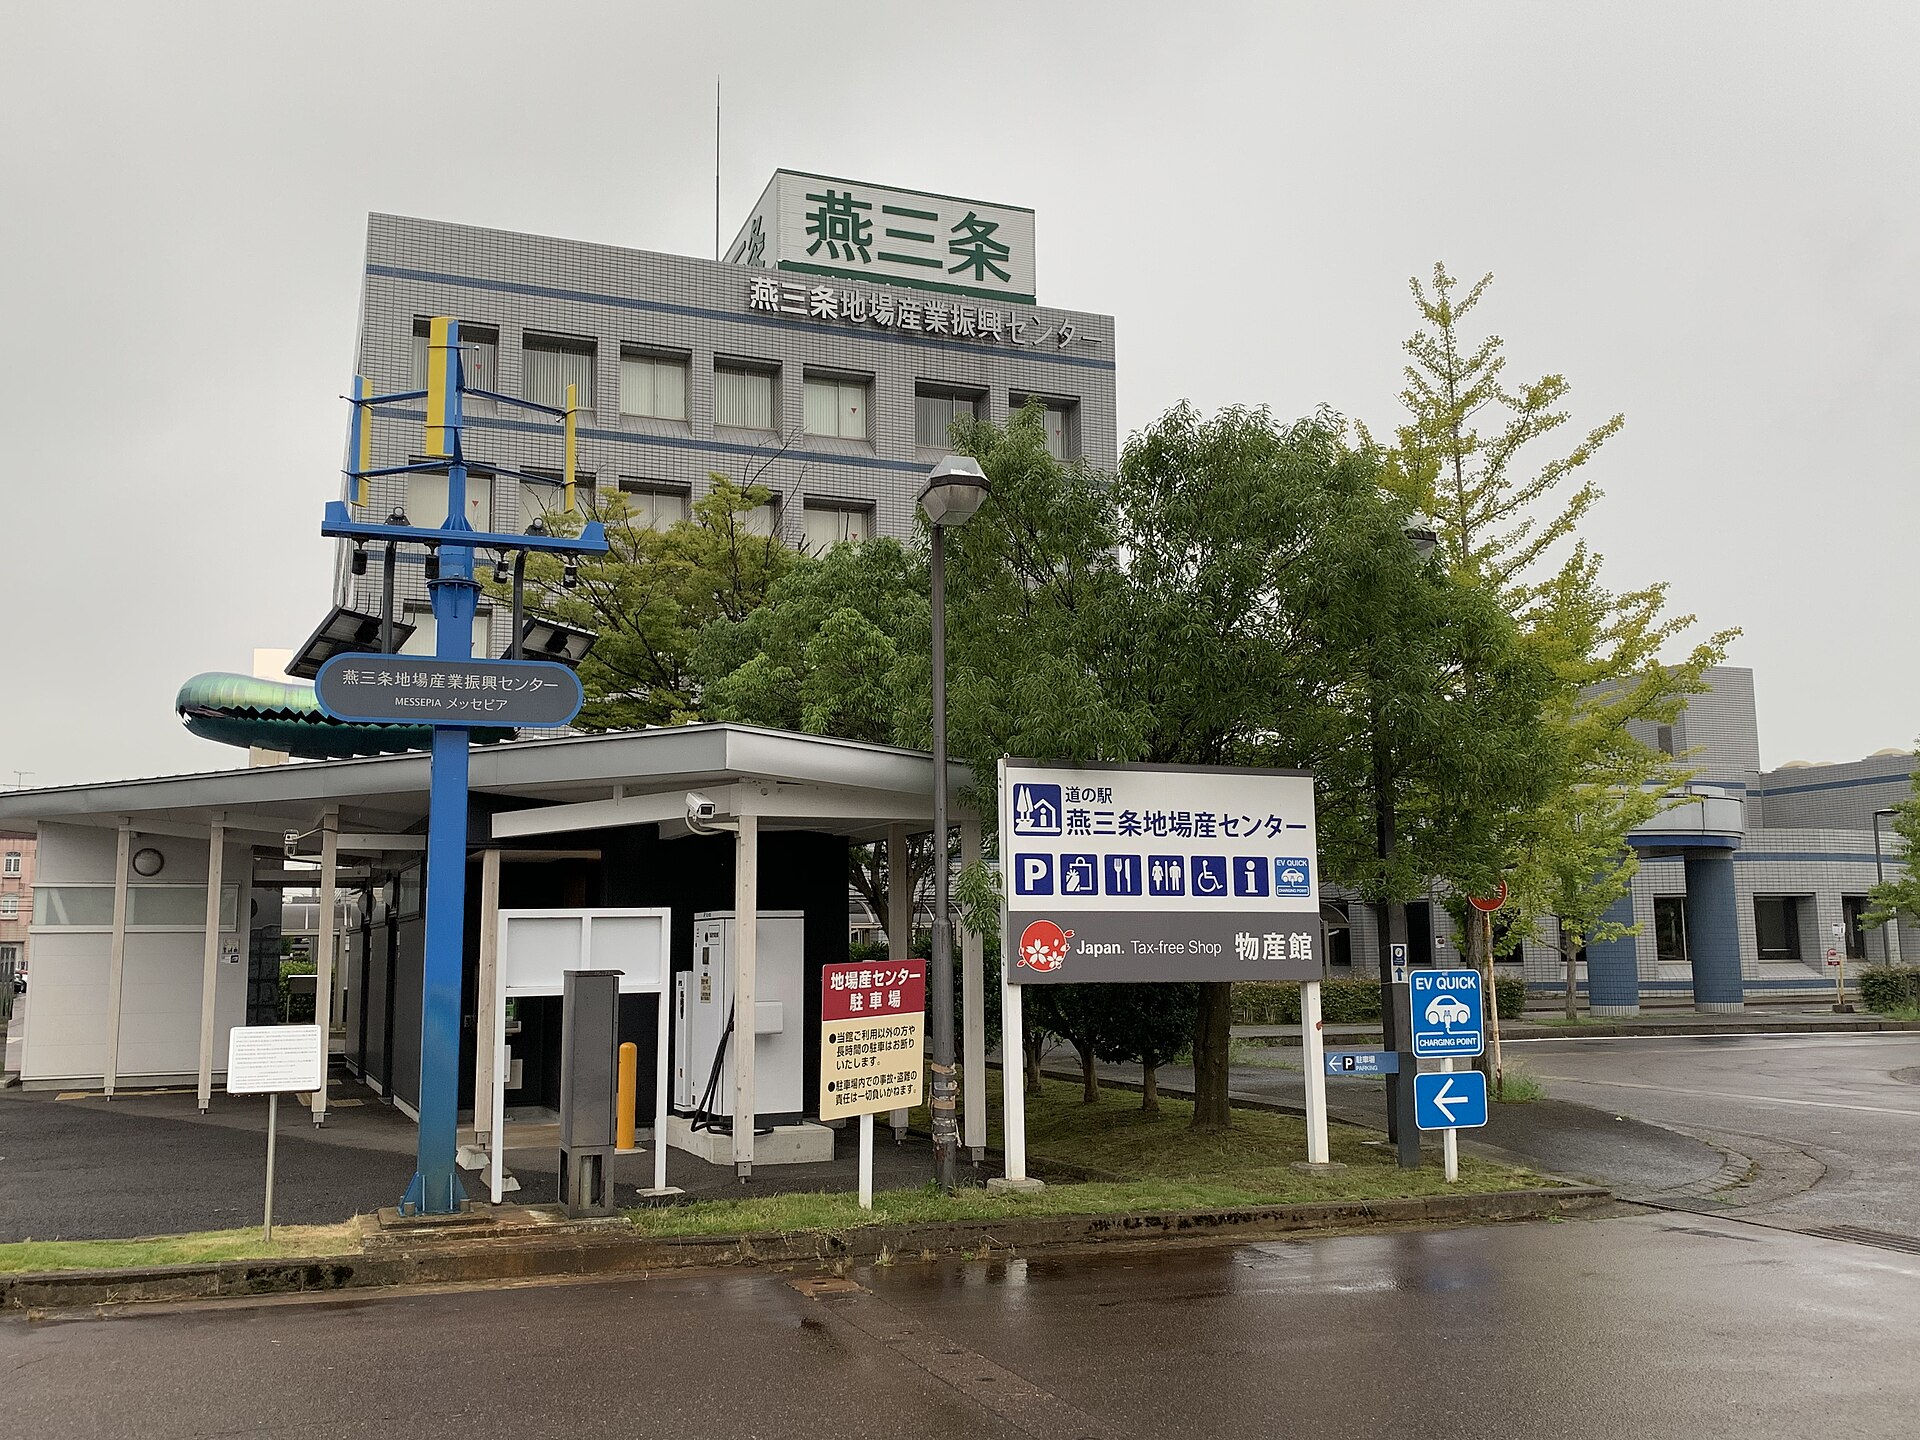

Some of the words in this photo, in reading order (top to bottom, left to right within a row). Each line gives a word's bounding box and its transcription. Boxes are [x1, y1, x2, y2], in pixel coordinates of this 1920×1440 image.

[806, 189, 1012, 283] 燕三条
[748, 276, 1102, 350] 燕三条地場産業振興センター
[342, 669, 559, 692] 燕三条地場産業振興センター
[395, 697, 442, 708] MESSEPIA
[446, 698, 508, 711] メッセピア
[1065, 786, 1113, 804] 道の駅
[1066, 808, 1307, 838] 燕三条地場産センター
[1076, 939, 1125, 956] Japan.
[1131, 940, 1185, 955] Tax-free
[1188, 939, 1222, 957] Shop
[1235, 932, 1313, 961] 物産館
[830, 968, 921, 991] 地場産センター
[1415, 977, 1433, 990] EV
[1436, 976, 1477, 990] QUICK
[850, 989, 901, 1012] 駐車場
[1419, 1038, 1455, 1047] CHARGING
[1456, 1037, 1477, 1046] POINT
